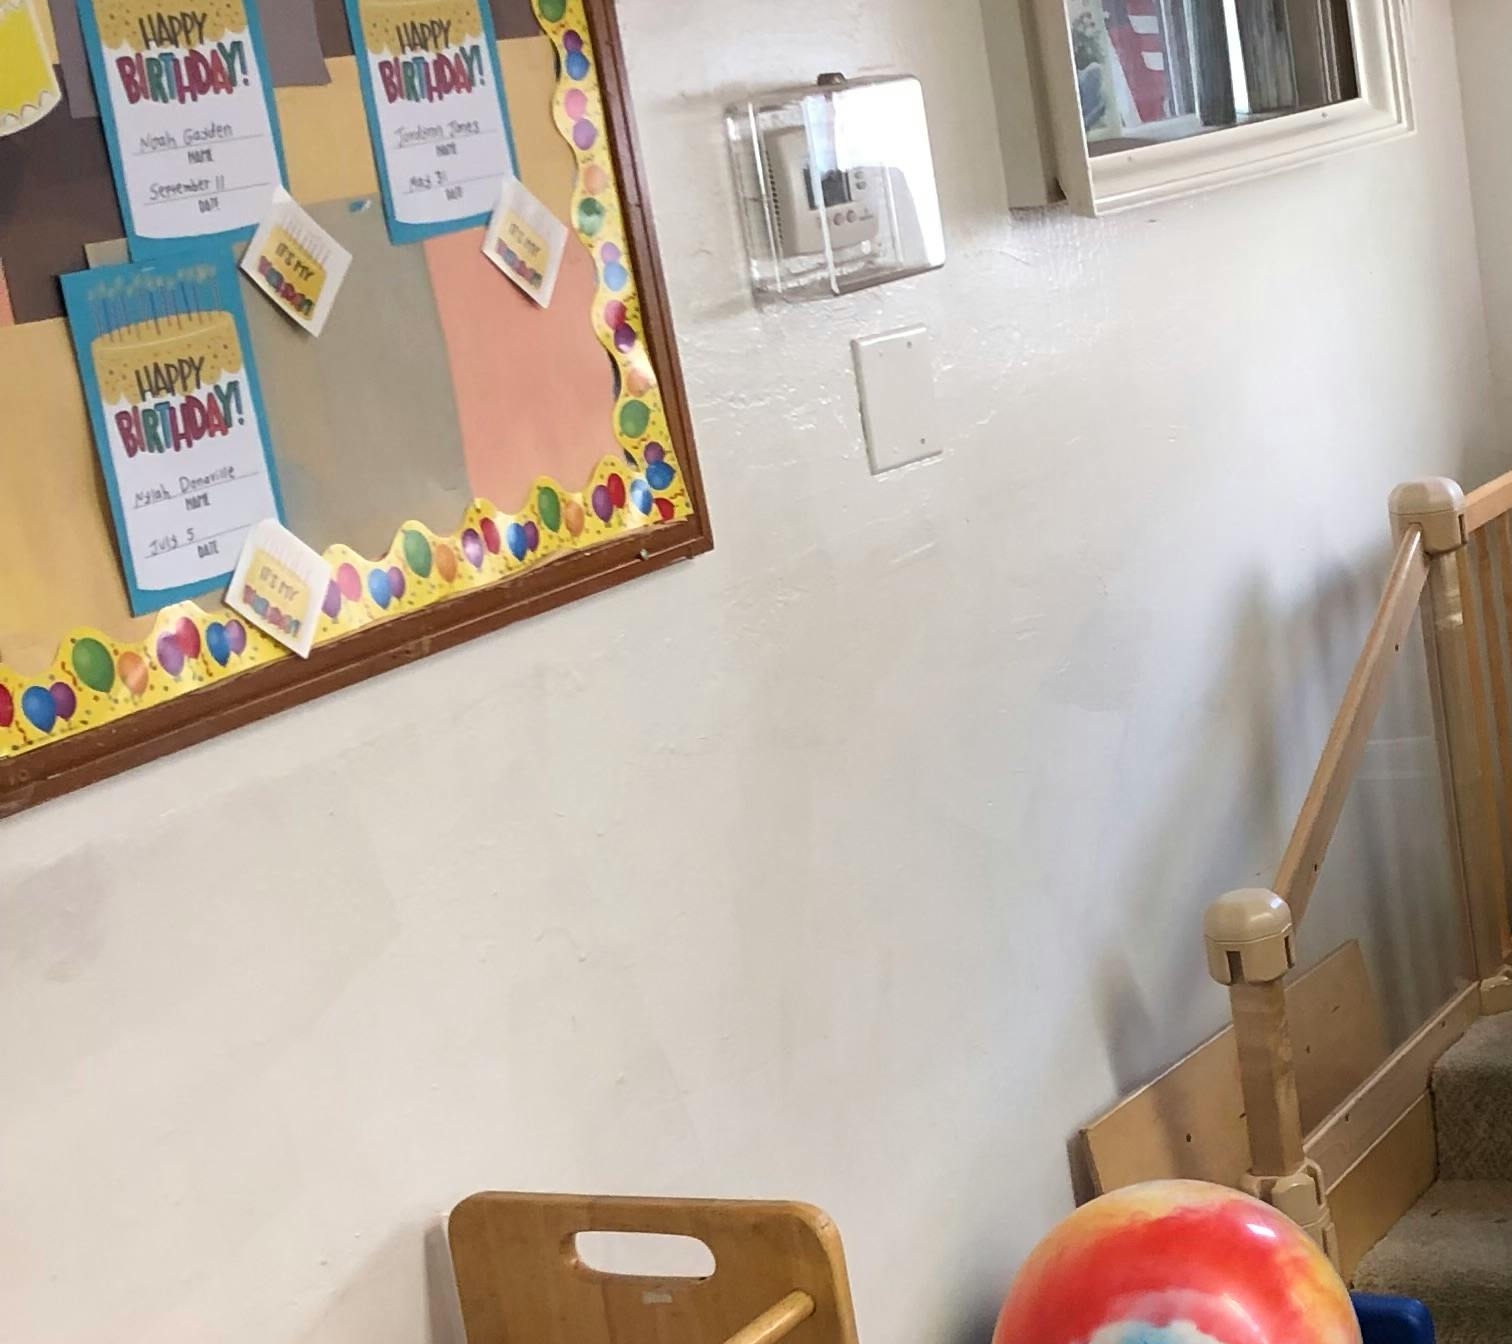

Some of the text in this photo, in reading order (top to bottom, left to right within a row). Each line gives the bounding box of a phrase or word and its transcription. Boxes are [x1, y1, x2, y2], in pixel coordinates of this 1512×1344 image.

[138, 11, 207, 49] HAPPY
[395, 18, 451, 54] HAPPY
[115, 40, 249, 105] BIRTHDAY!
[378, 44, 486, 104] BIRTHDAY!
[188, 148, 214, 164] NAME
[135, 356, 205, 401] HAPPY
[115, 380, 245, 458] BIRTHDAY!
[185, 492, 210, 511] NAME
[186, 527, 195, 542] 5
[197, 540, 220, 559] DATE
